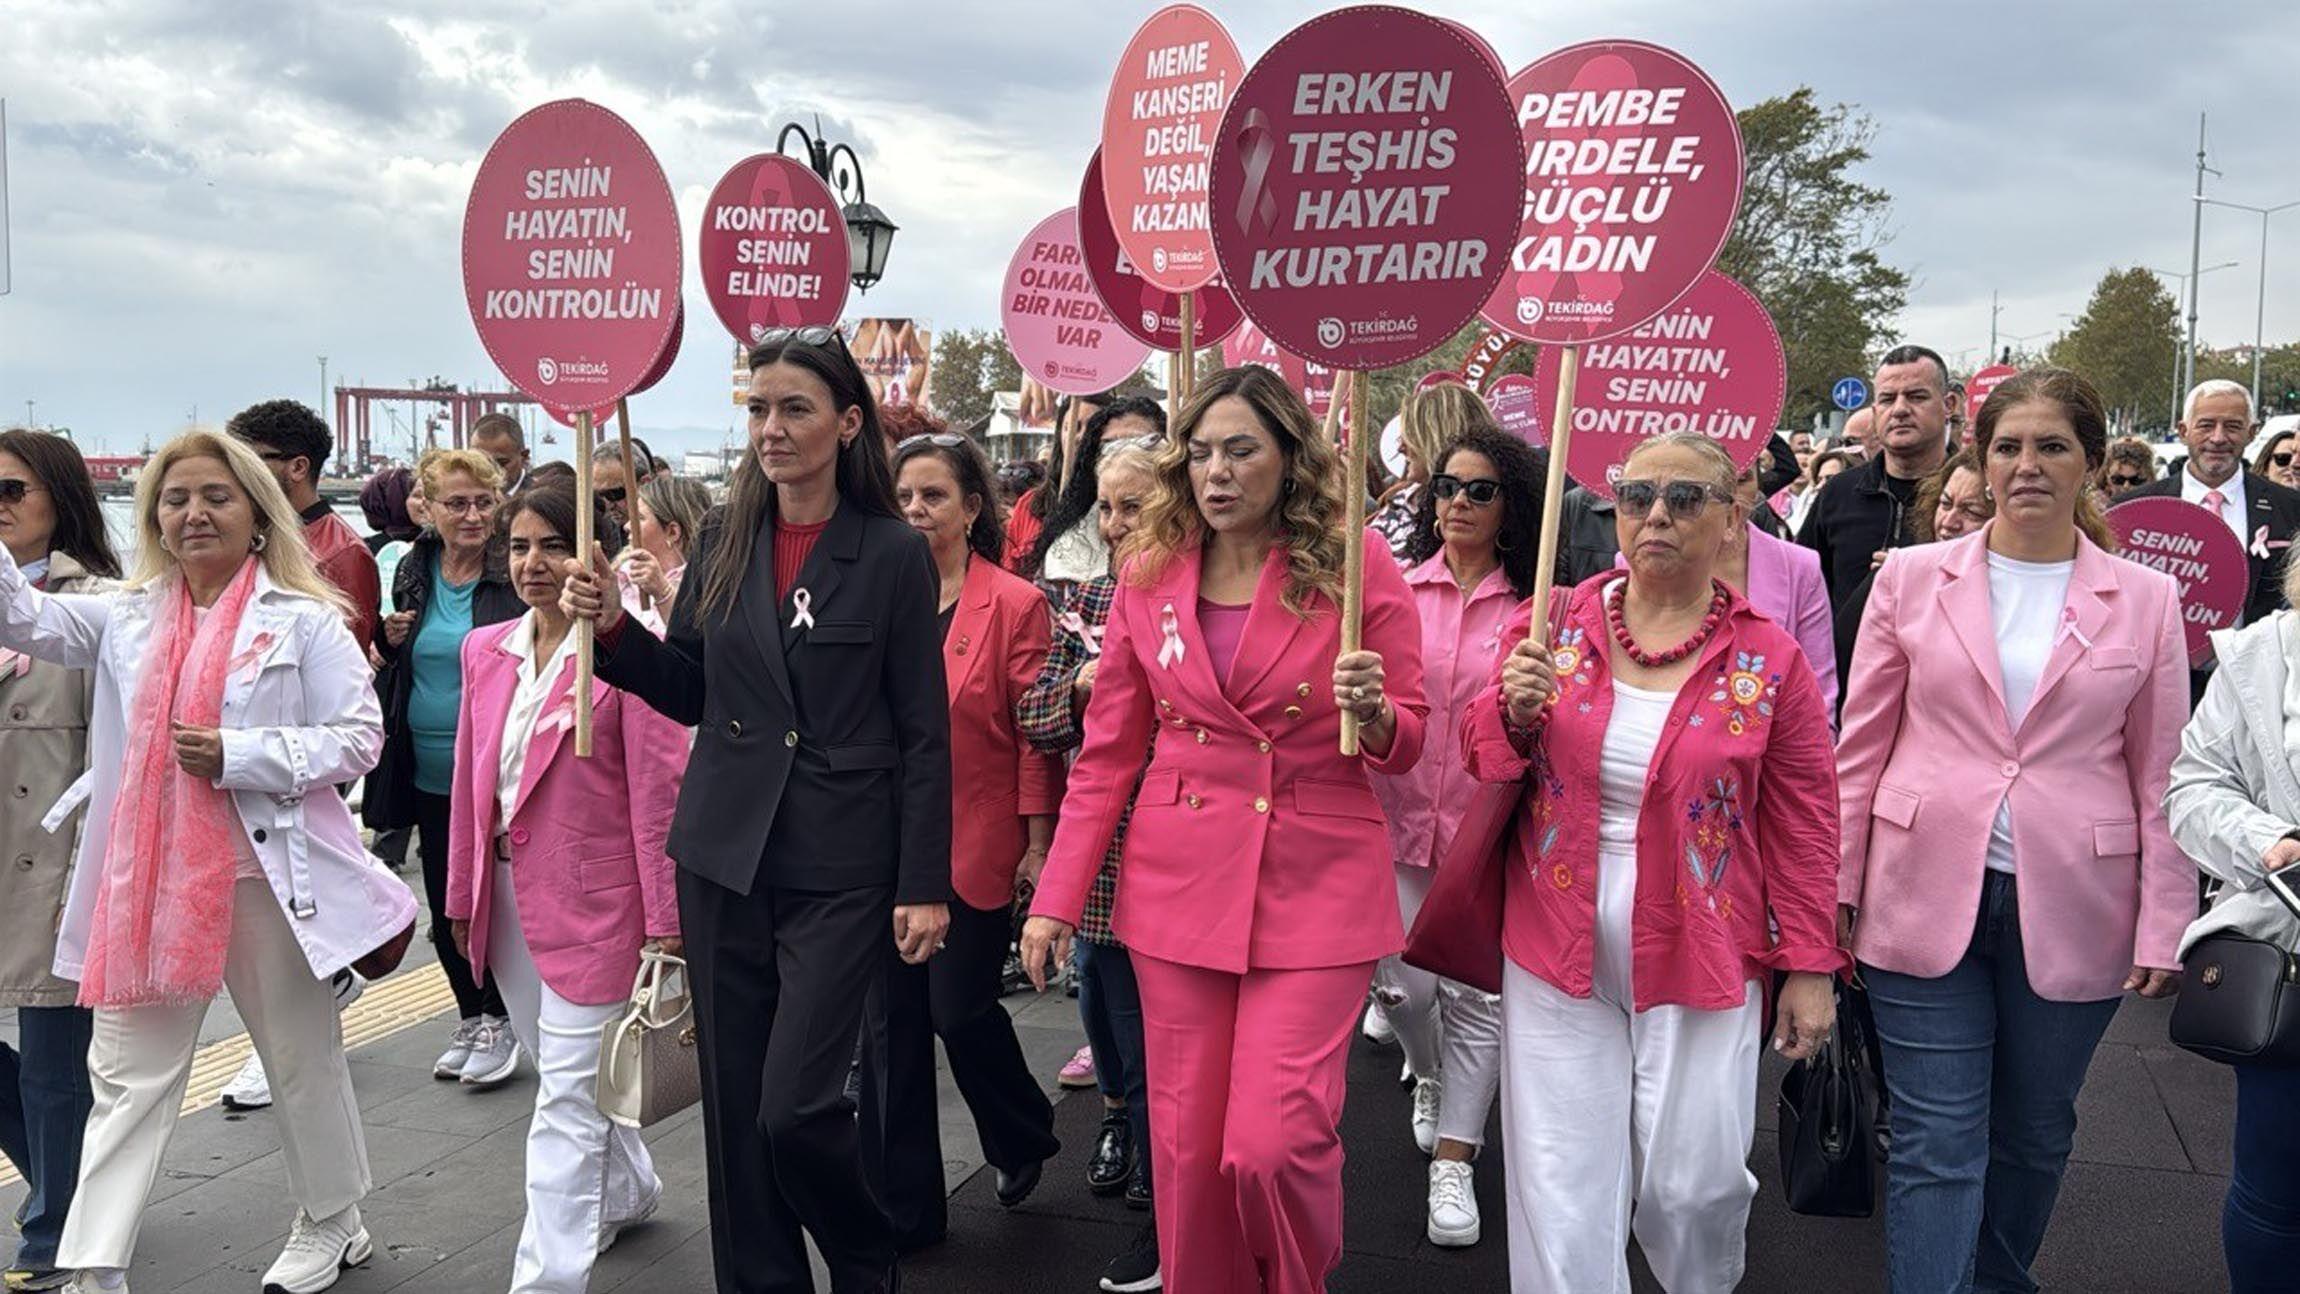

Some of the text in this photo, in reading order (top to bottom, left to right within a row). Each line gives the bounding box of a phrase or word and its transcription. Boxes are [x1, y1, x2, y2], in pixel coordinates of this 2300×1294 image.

[1147, 41, 1209, 79] MEME
[1132, 70, 1226, 120] KANSERİ
[1293, 70, 1452, 115] ERKEN
[1517, 87, 1686, 129] PEMBE
[1144, 115, 1210, 157] DEĞİL,
[1289, 117, 1457, 183] TEŞHİS
[1525, 135, 1705, 182] RDELE,
[525, 158, 611, 200] SENİN
[505, 207, 632, 243] HAYATIN,
[715, 206, 830, 233] KONTROL
[1294, 185, 1450, 231] HAYAT
[528, 239, 613, 279] SENİN
[737, 233, 811, 266] SENİN
[1250, 239, 1488, 290] KURTARIR
[1511, 235, 1657, 272] KADIN
[727, 265, 822, 300] ELİNDE!
[1020, 267, 1094, 294] OLMA
[485, 281, 661, 320] KONTROLÜN
[1012, 290, 1117, 324] BİR NEDE
[1548, 299, 1614, 314] TEKİRDAĞ
[1056, 325, 1102, 349] VAR
[1350, 314, 1418, 334] TEKİRDAĞ
[1622, 307, 1713, 340] ENİN
[1584, 344, 1731, 379] HAYATIN,
[1606, 373, 1706, 405] SENİN
[1571, 408, 1756, 440] ONTROLÜN
[2129, 529, 2204, 557] SENİN
